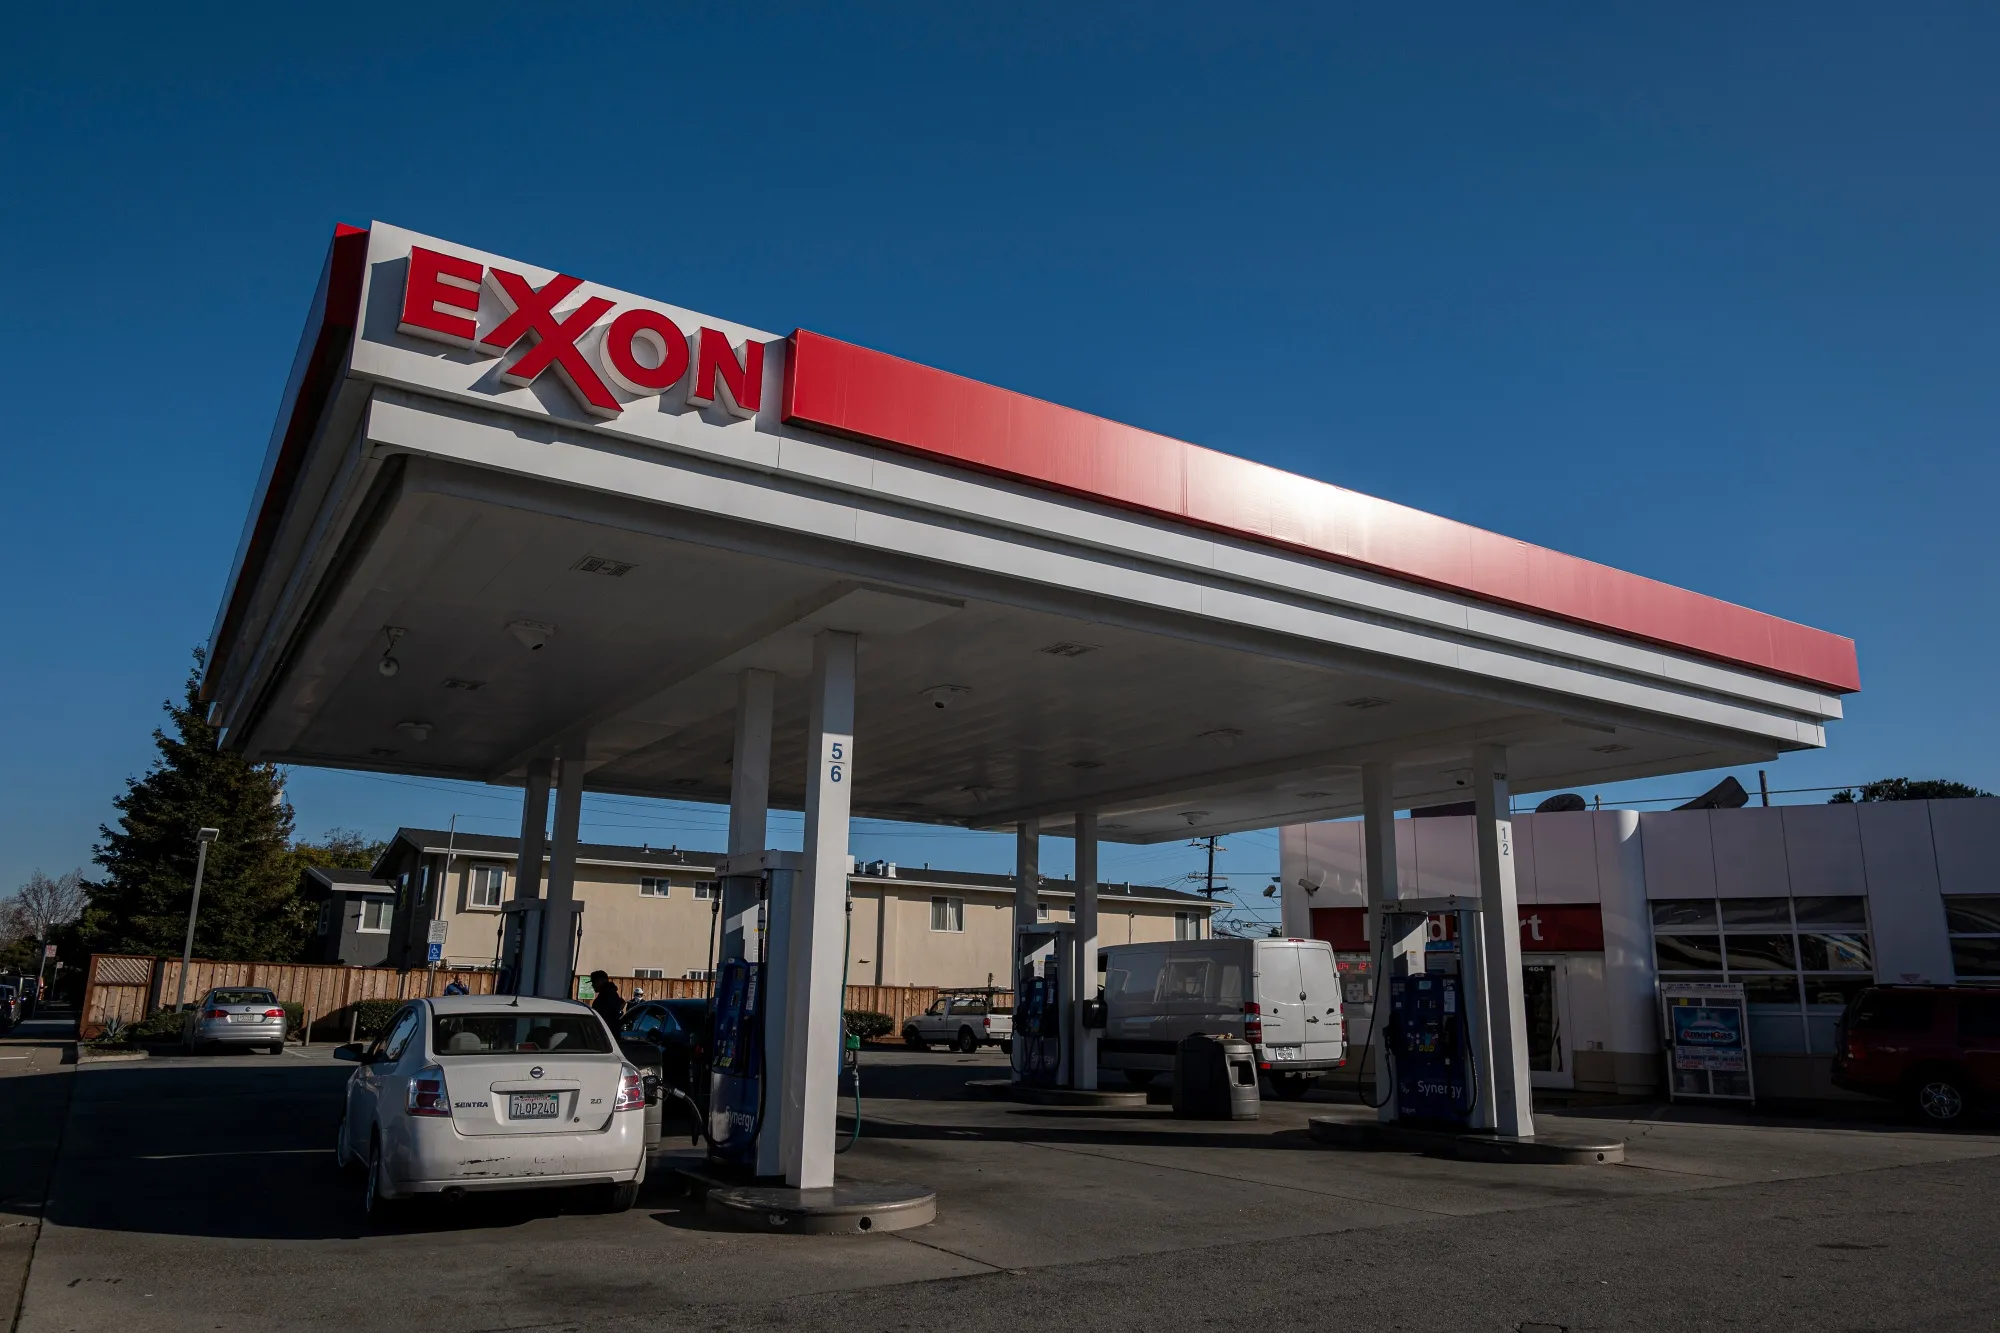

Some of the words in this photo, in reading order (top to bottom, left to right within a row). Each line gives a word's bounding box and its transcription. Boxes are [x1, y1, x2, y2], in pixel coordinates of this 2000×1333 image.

[399, 246, 766, 417] EXXON
[832, 742, 843, 760] 5
[831, 765, 842, 783] 6
[1501, 827, 1507, 839] 1
[1502, 843, 1509, 856] 2
[1519, 913, 1544, 941] rt
[1683, 1029, 1734, 1040] AmeriGas
[1417, 1080, 1462, 1099] Synergy
